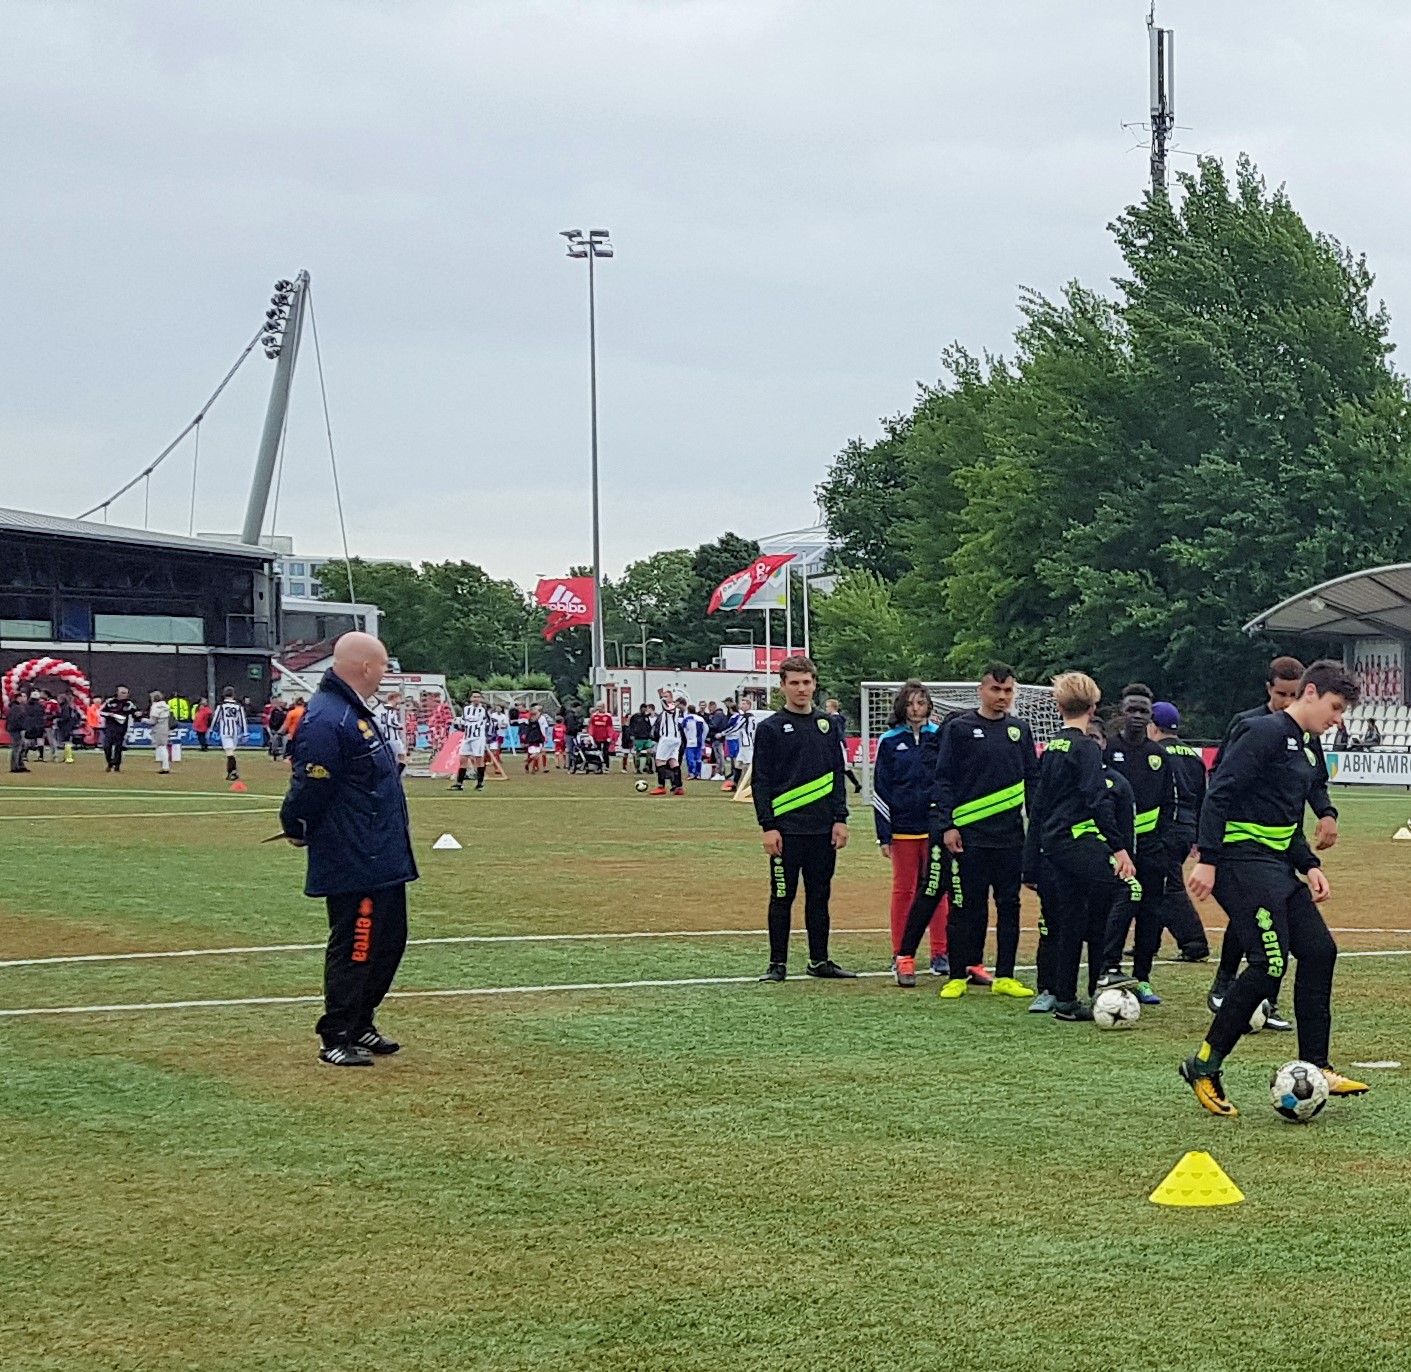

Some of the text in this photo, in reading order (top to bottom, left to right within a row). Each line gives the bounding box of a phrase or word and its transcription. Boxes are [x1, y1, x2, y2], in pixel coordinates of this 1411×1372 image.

[924, 862, 942, 897] errea
[351, 917, 372, 962] errea
[1261, 930, 1285, 978] errea
